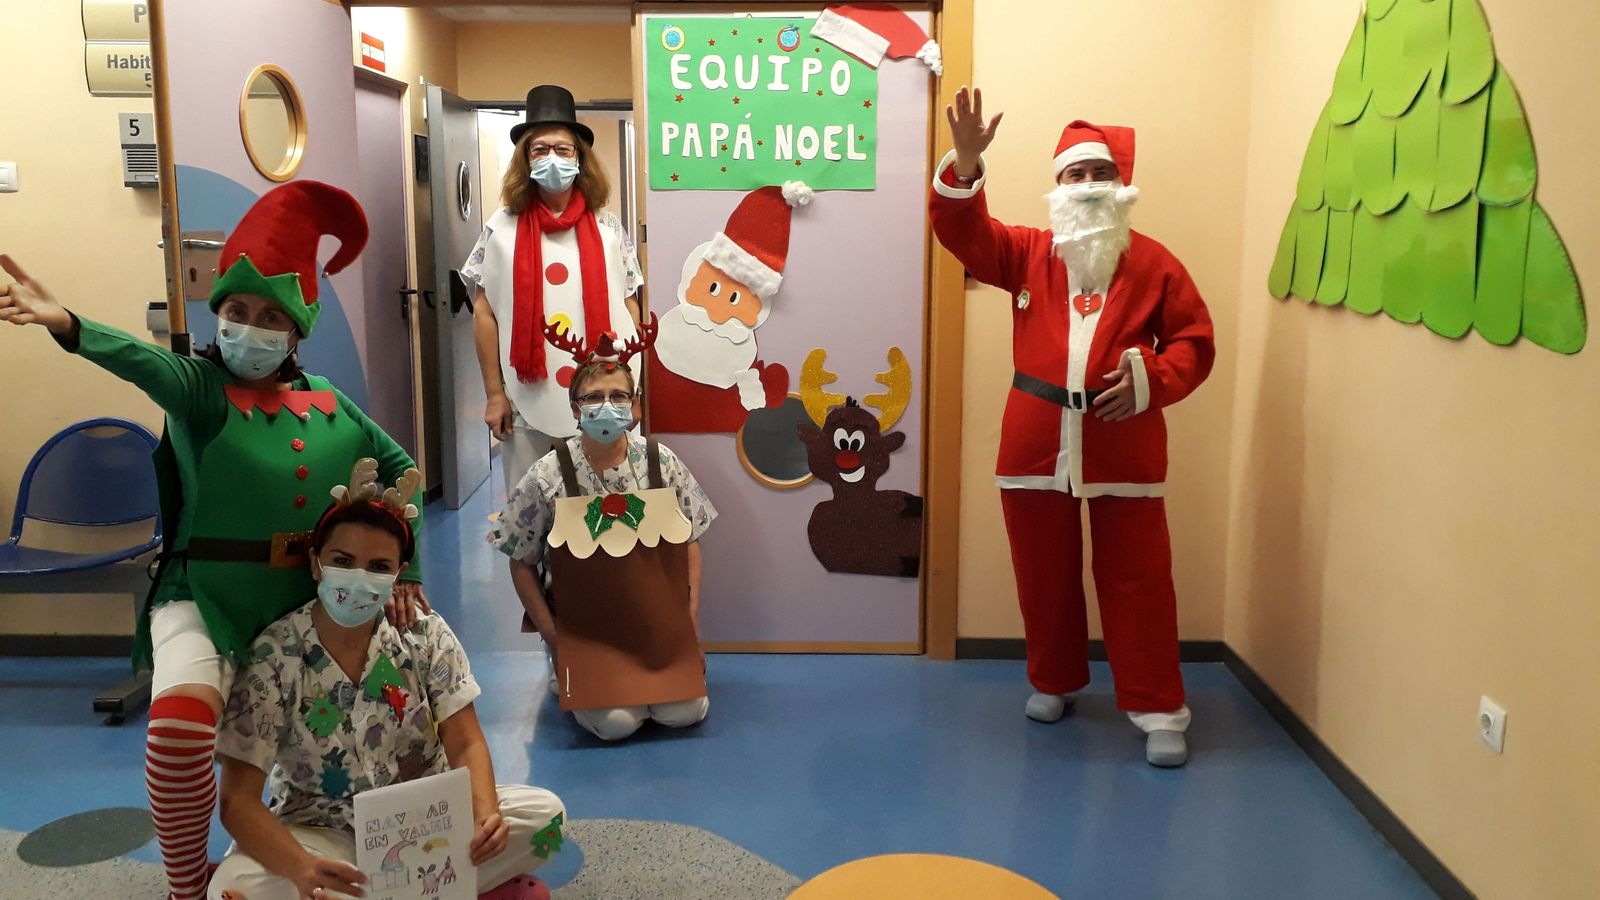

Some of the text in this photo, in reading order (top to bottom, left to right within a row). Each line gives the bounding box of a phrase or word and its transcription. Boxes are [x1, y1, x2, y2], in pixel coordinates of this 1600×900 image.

[670, 54, 851, 96] EQUIPO
[129, 119, 140, 137] 5
[661, 112, 867, 160] PAPÁ NOEL
[366, 801, 449, 834] NAVAD
[364, 834, 389, 851] EN
